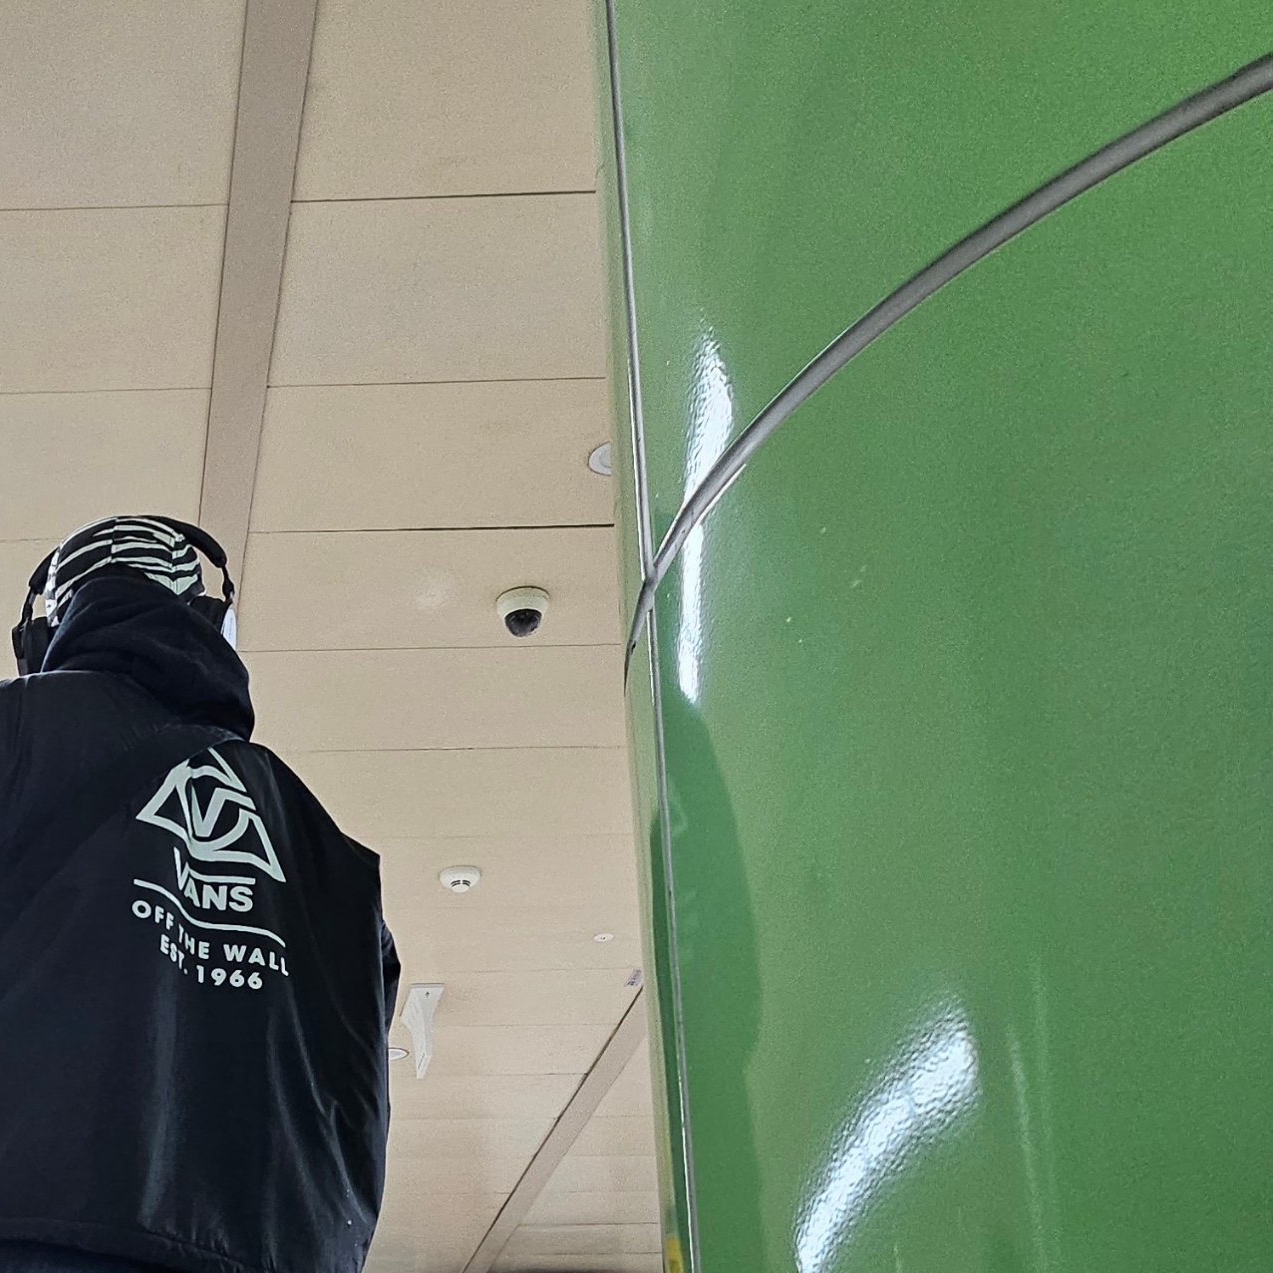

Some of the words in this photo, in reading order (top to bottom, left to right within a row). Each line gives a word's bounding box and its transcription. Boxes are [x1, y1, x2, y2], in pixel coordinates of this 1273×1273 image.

[173, 846, 256, 912] VANS
[131, 899, 174, 930] OFF
[178, 925, 211, 960] THE
[223, 943, 289, 977] WALL
[159, 933, 189, 975] EST.
[196, 964, 263, 990] 1966
